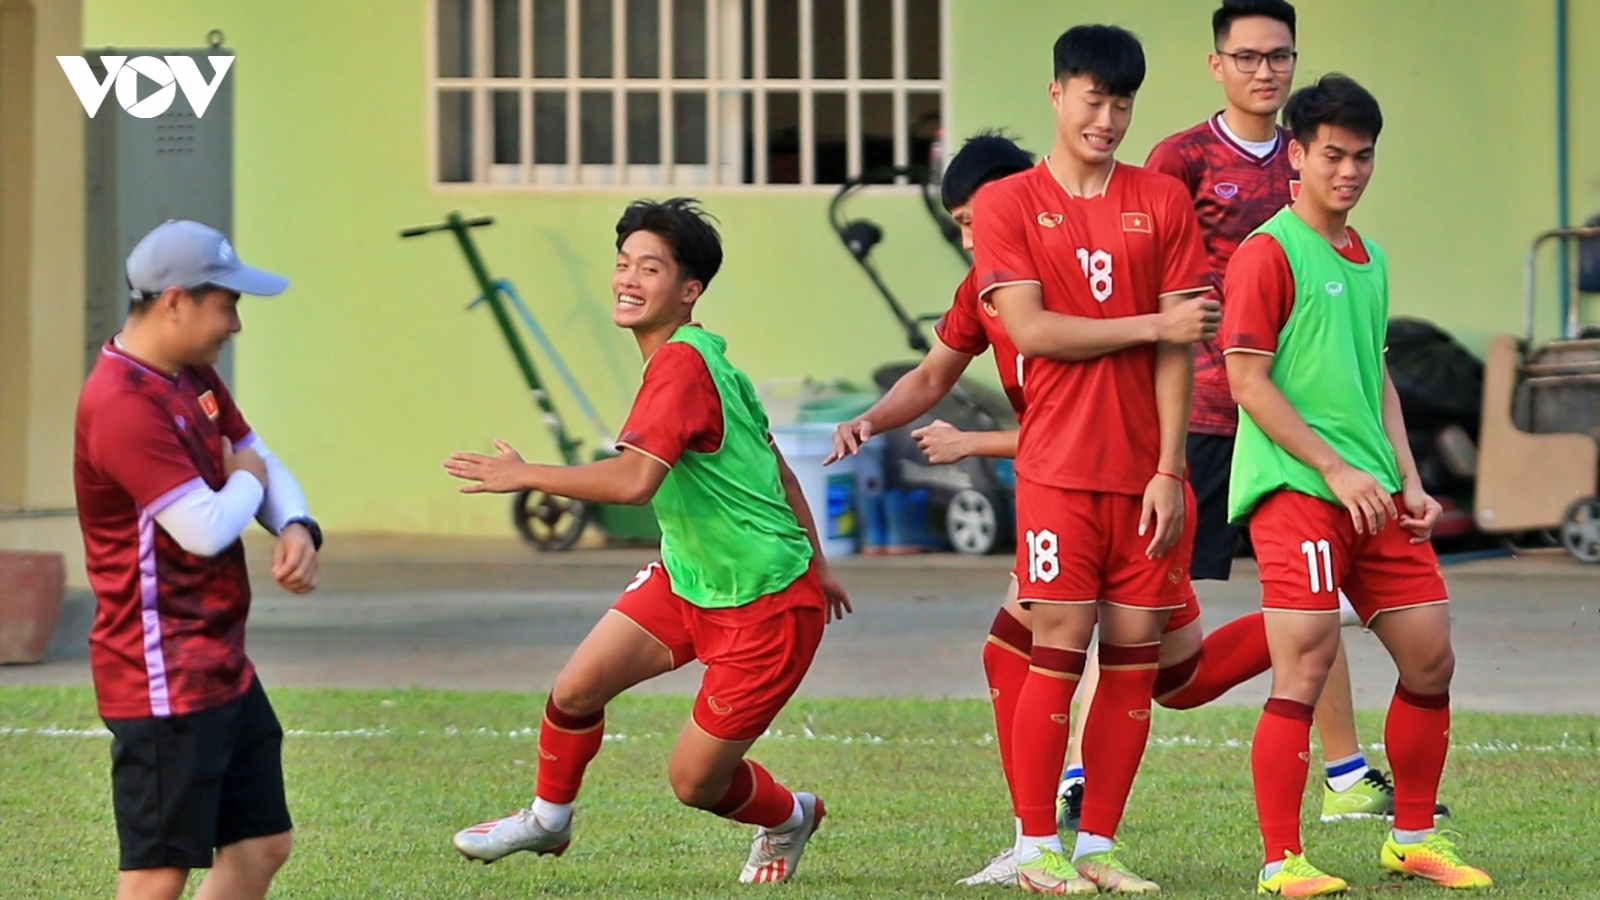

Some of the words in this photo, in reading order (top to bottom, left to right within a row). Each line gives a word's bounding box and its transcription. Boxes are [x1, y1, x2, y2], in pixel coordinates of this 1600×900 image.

[1076, 247, 1113, 303] 18
[1026, 528, 1060, 583] 18
[1301, 538, 1334, 593] 11
